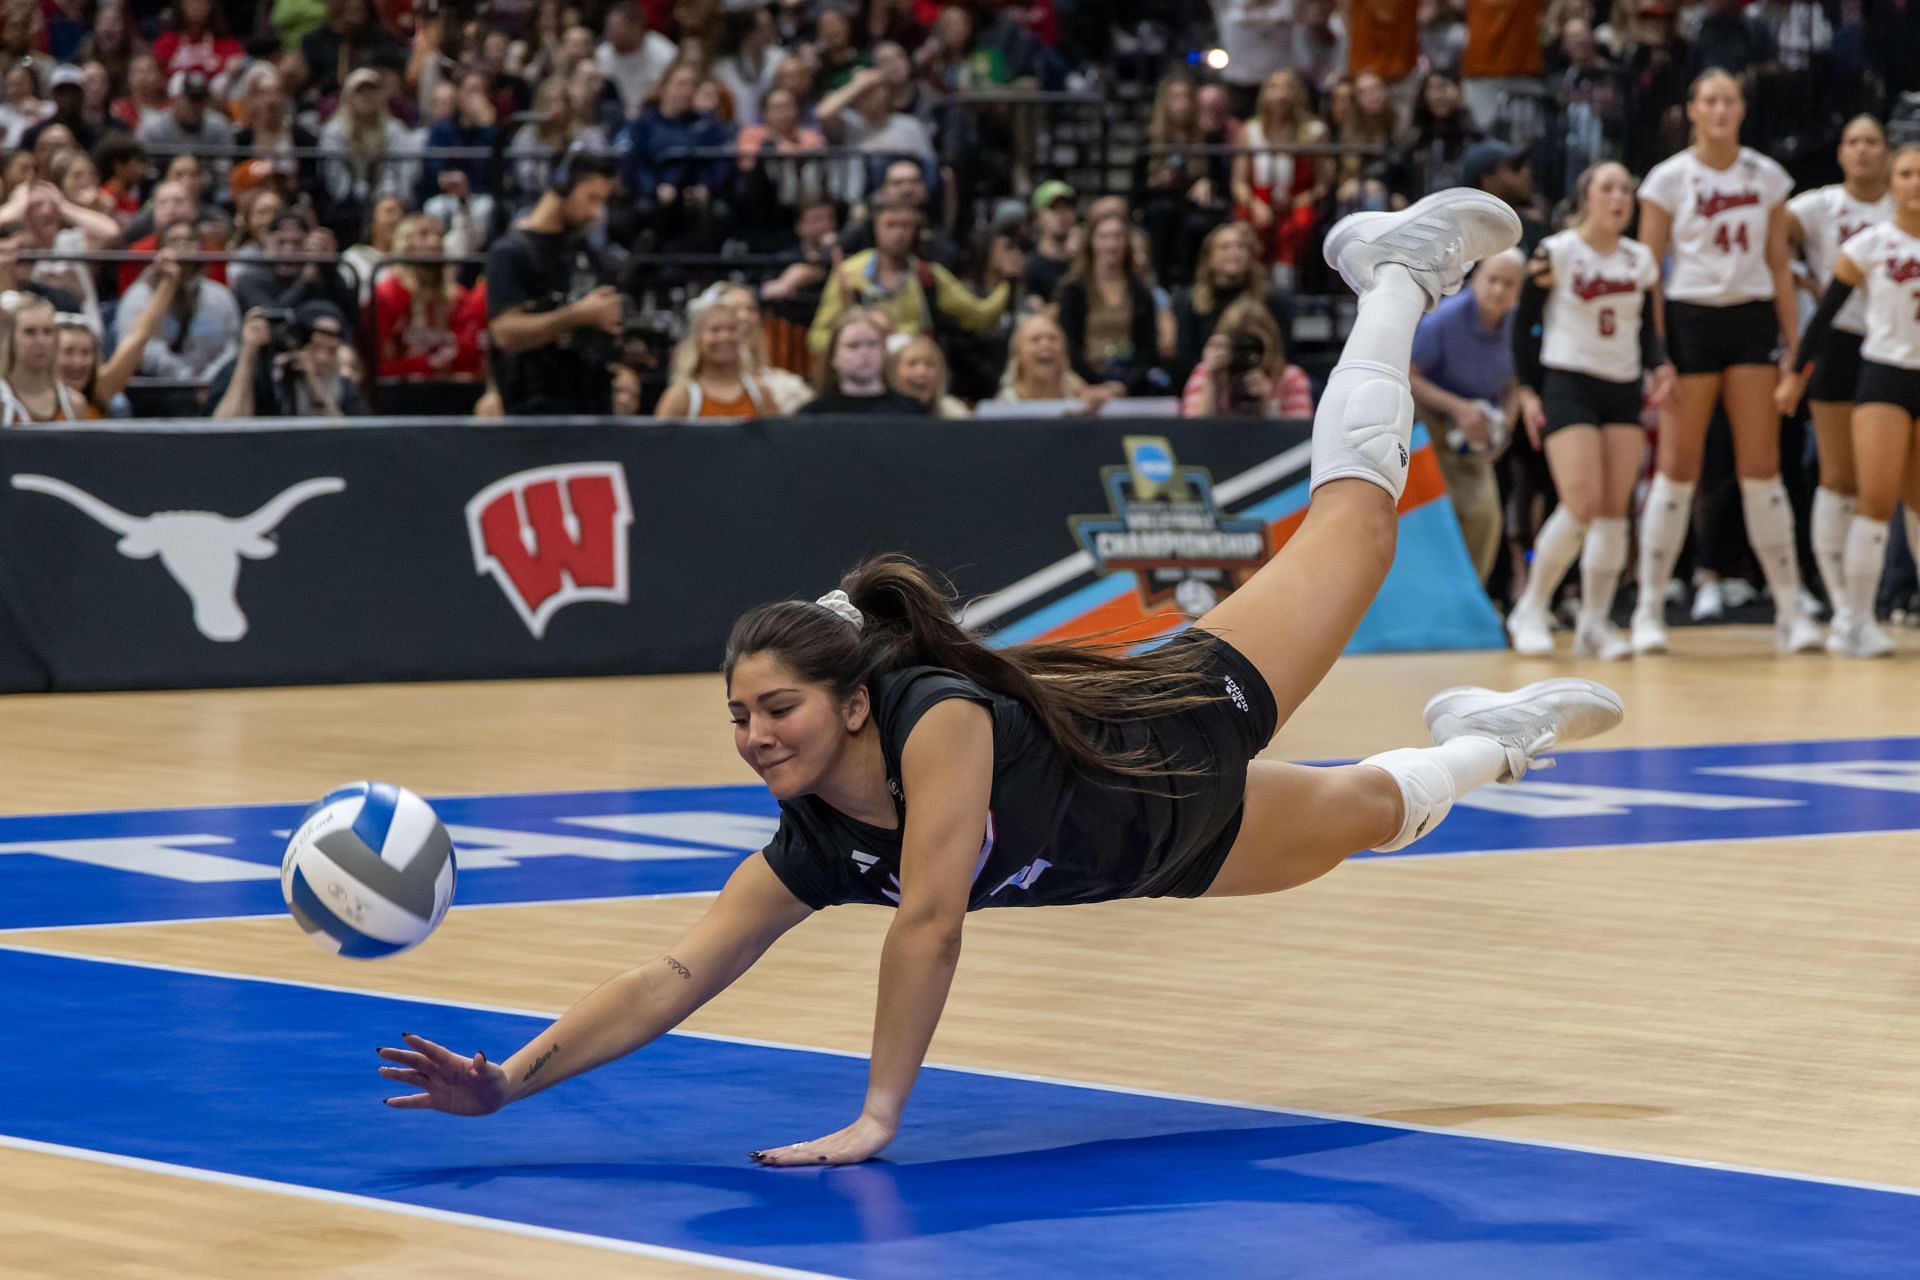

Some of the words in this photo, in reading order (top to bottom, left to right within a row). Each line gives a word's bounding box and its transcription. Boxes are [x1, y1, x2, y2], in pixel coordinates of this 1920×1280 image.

[1714, 222, 1748, 253] 44
[470, 464, 630, 634] W
[1224, 675, 1249, 712] adidas
